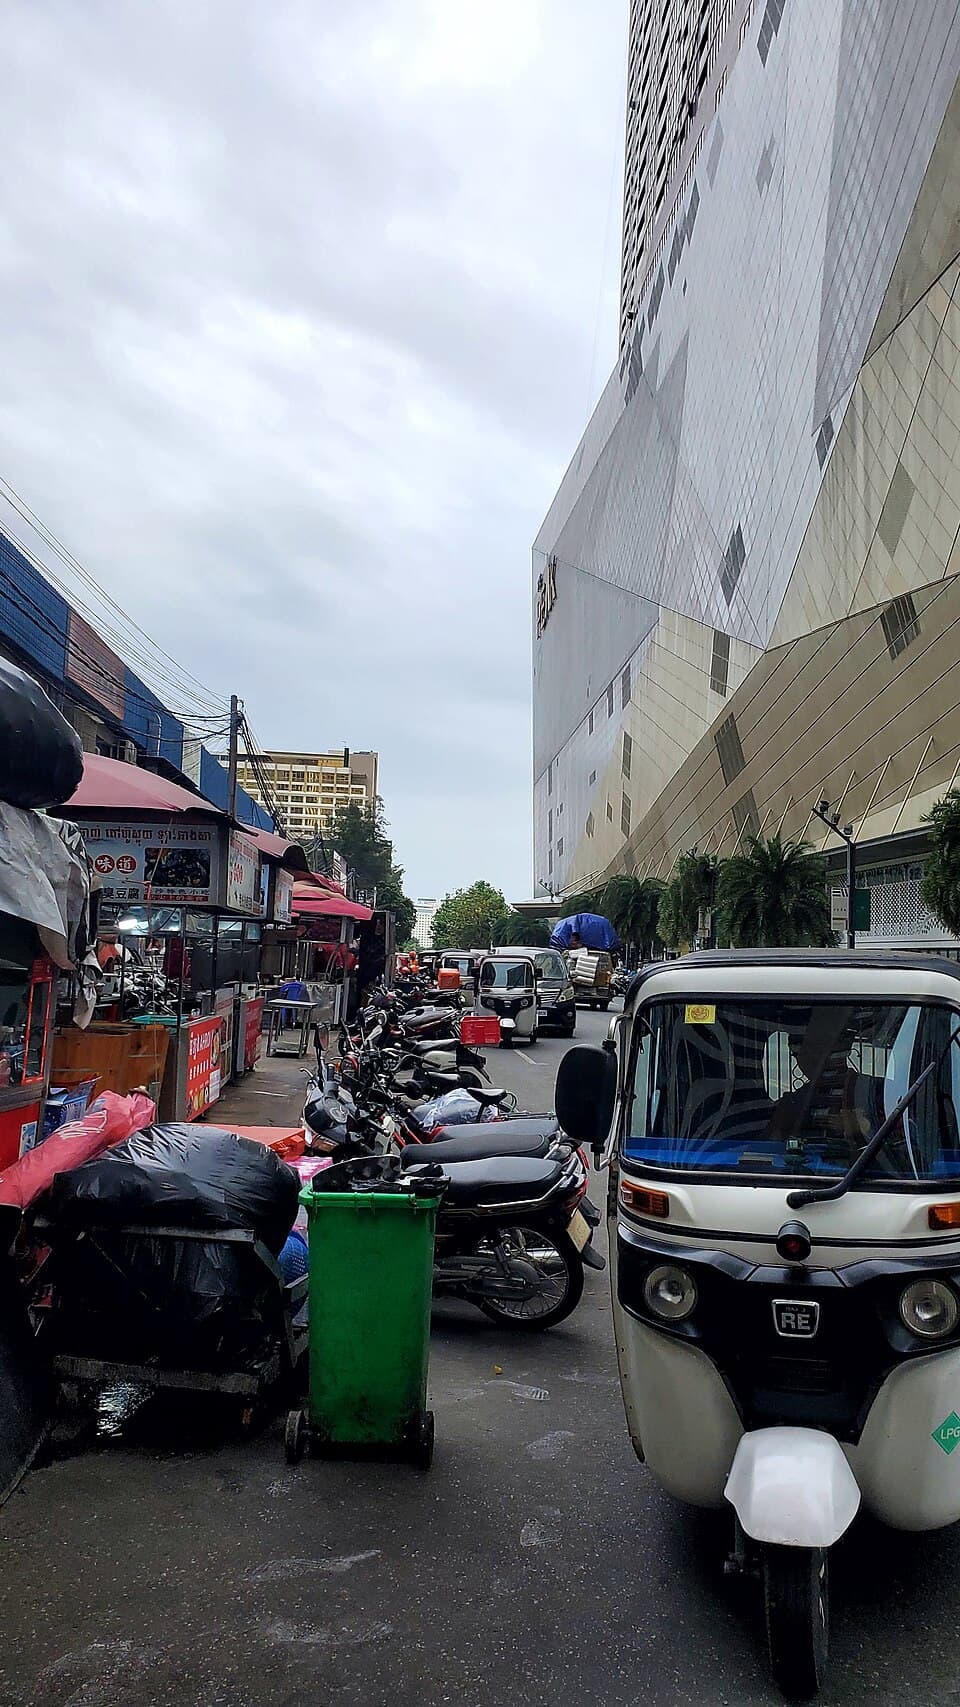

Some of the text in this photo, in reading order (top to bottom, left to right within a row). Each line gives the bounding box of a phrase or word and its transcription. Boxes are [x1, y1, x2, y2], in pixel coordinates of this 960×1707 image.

[102, 887, 140, 900] 臭豆腐
[781, 1312, 811, 1330] RE
[940, 1426, 960, 1440] LPG
